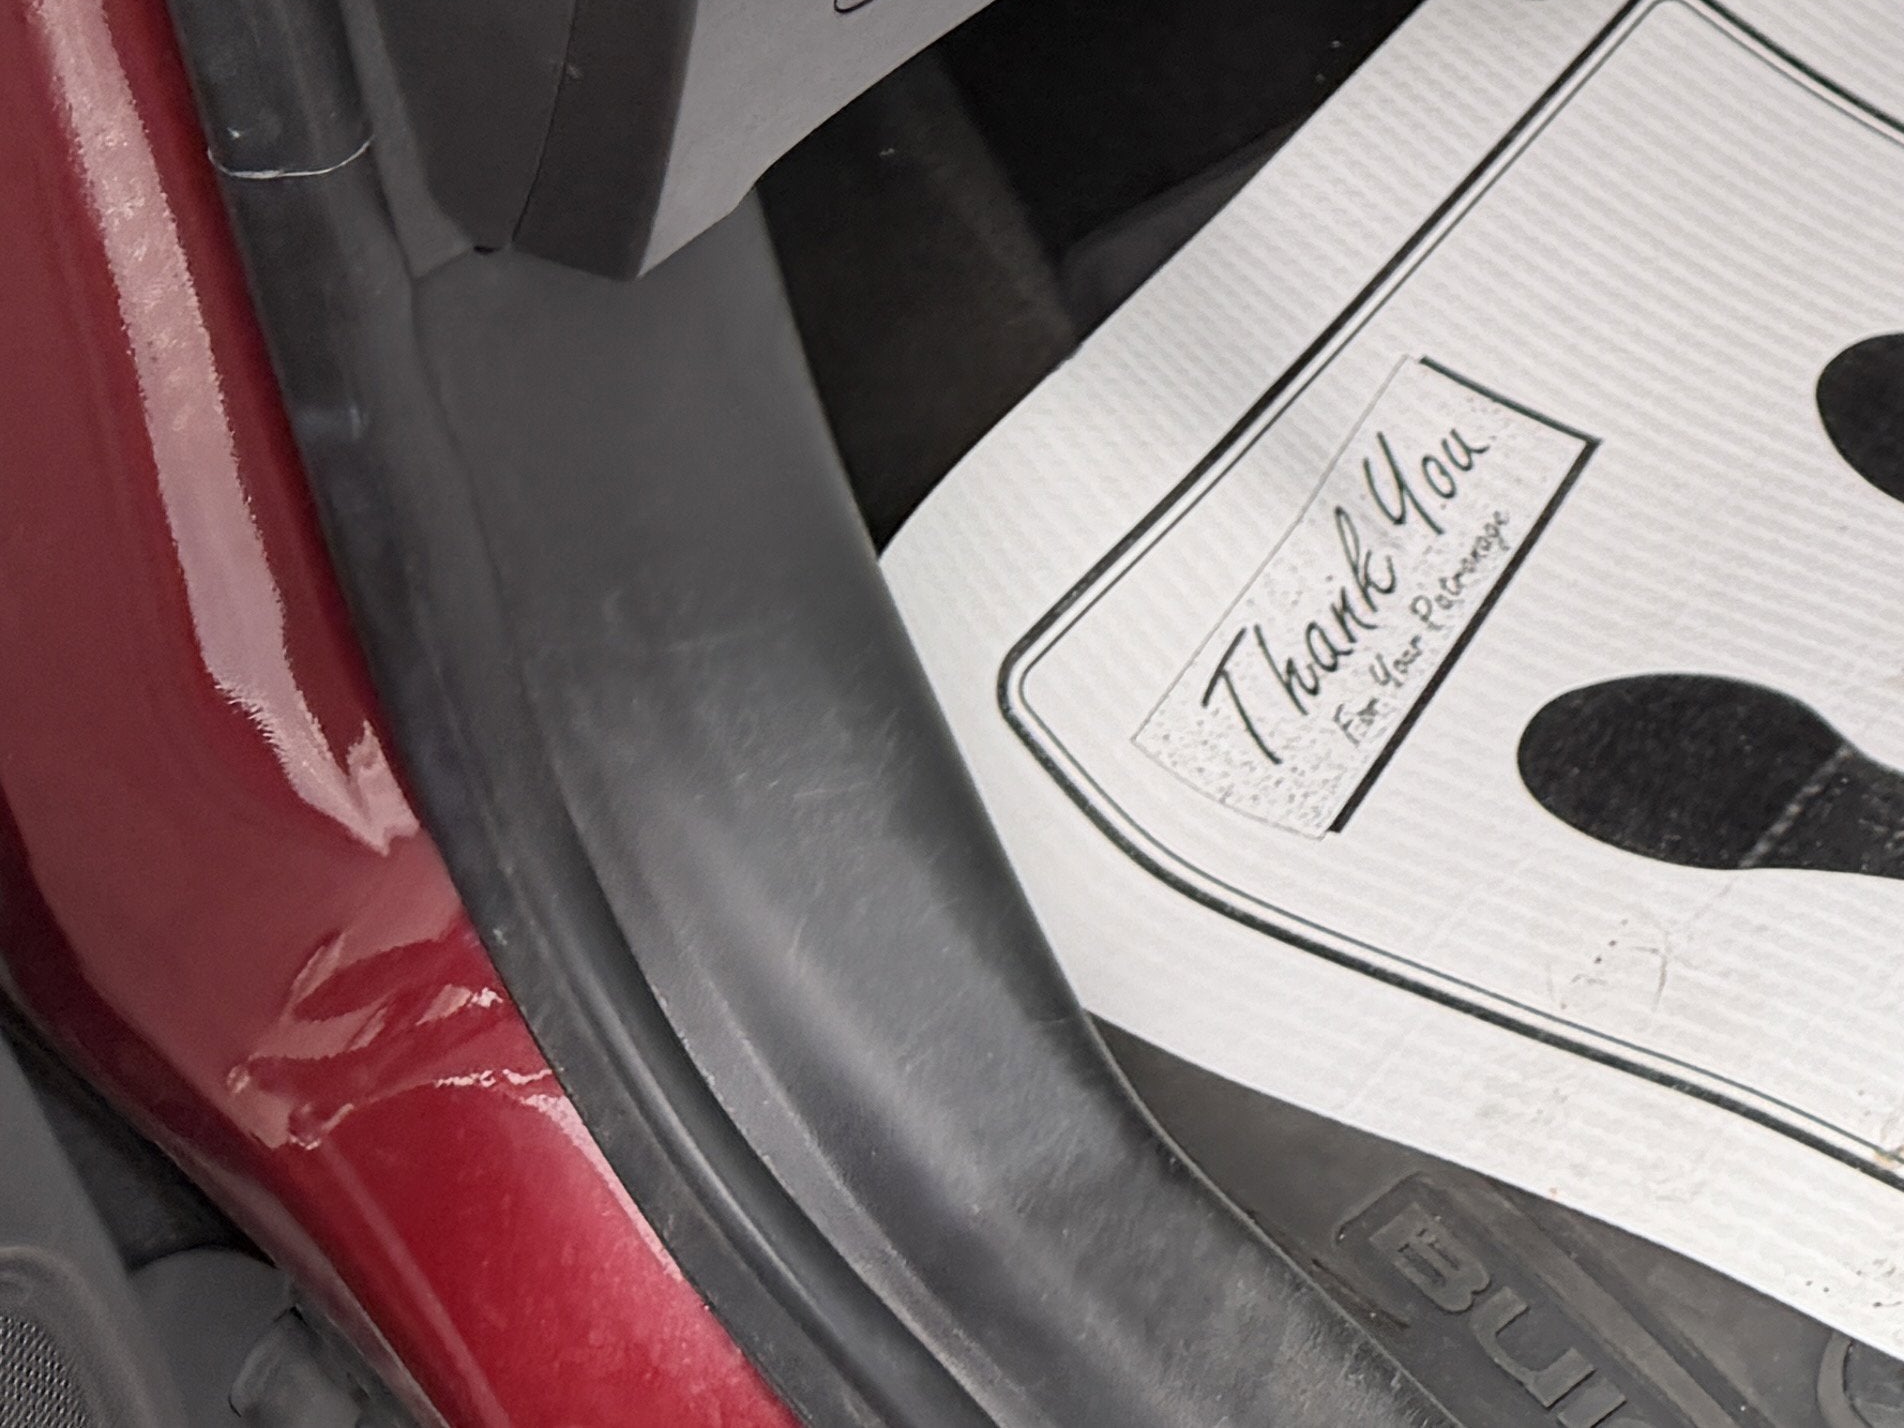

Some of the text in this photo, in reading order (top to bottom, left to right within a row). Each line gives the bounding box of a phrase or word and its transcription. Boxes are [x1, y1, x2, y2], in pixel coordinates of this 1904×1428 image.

[1201, 427, 1488, 766] Thank You
[1367, 1200, 1655, 1428] BUI
